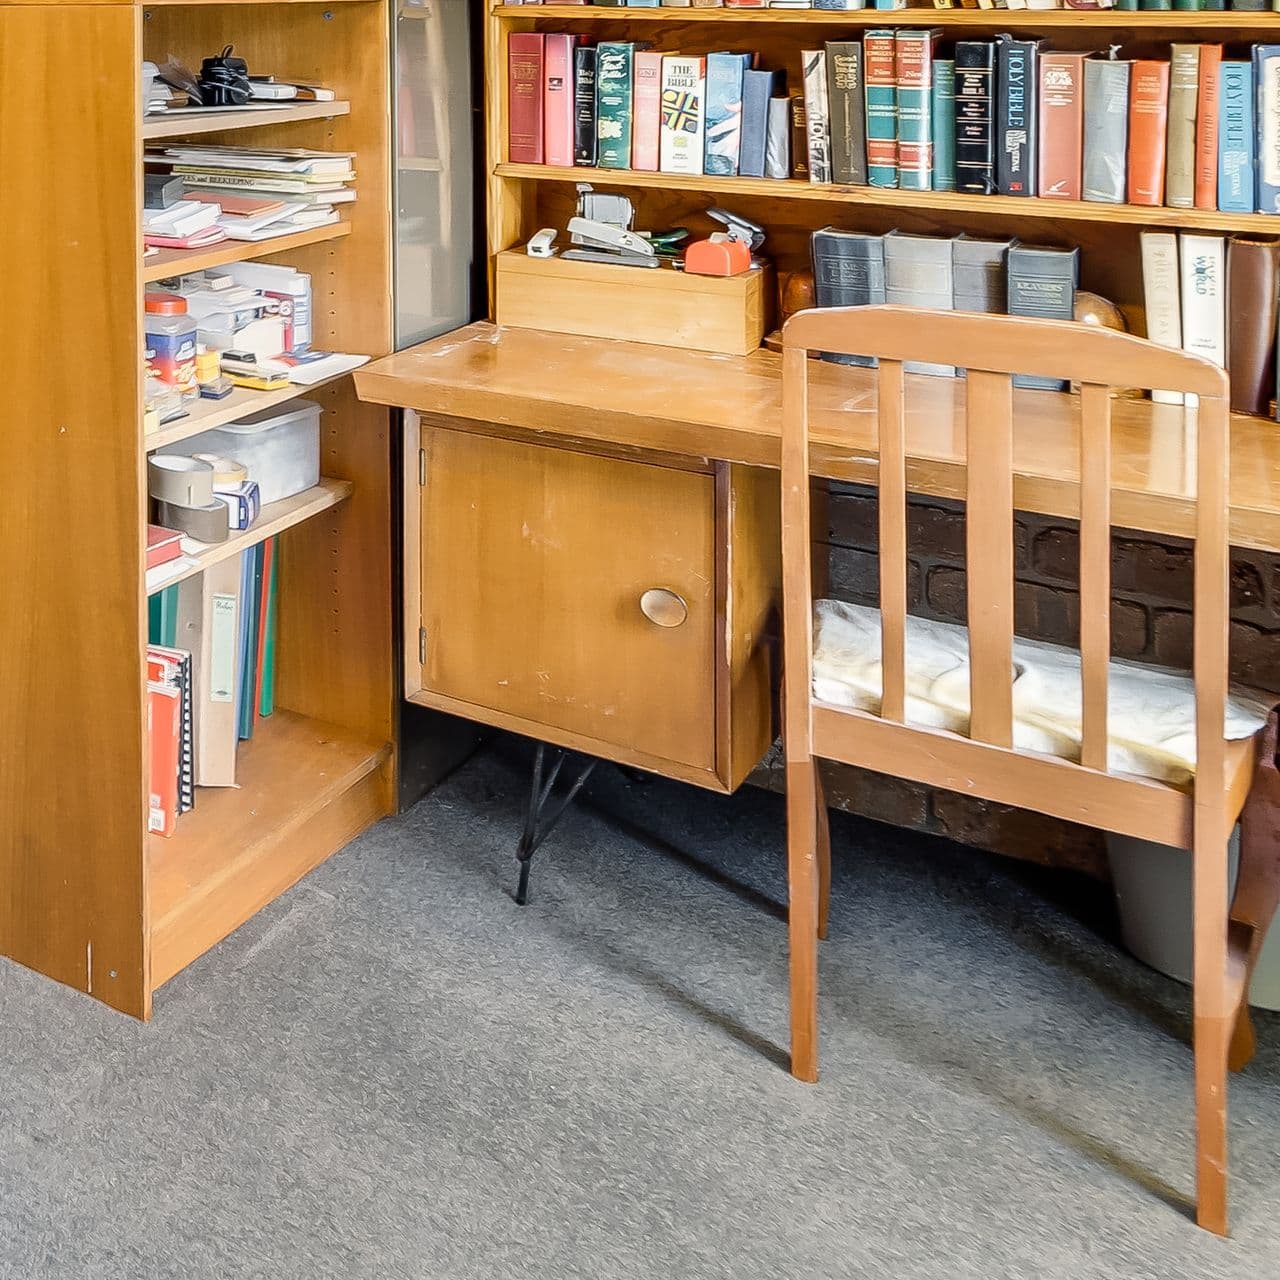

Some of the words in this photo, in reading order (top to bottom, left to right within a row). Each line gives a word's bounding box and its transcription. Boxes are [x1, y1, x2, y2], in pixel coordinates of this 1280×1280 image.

[667, 78, 696, 88] BIBLE
[671, 65, 693, 74] THE
[1008, 49, 1024, 86] HOLY
[1226, 66, 1243, 99] HOLY
[1008, 86, 1024, 126] BIBLE
[1226, 105, 1244, 148] BIBLE
[209, 176, 255, 186] BEEKEEPING
